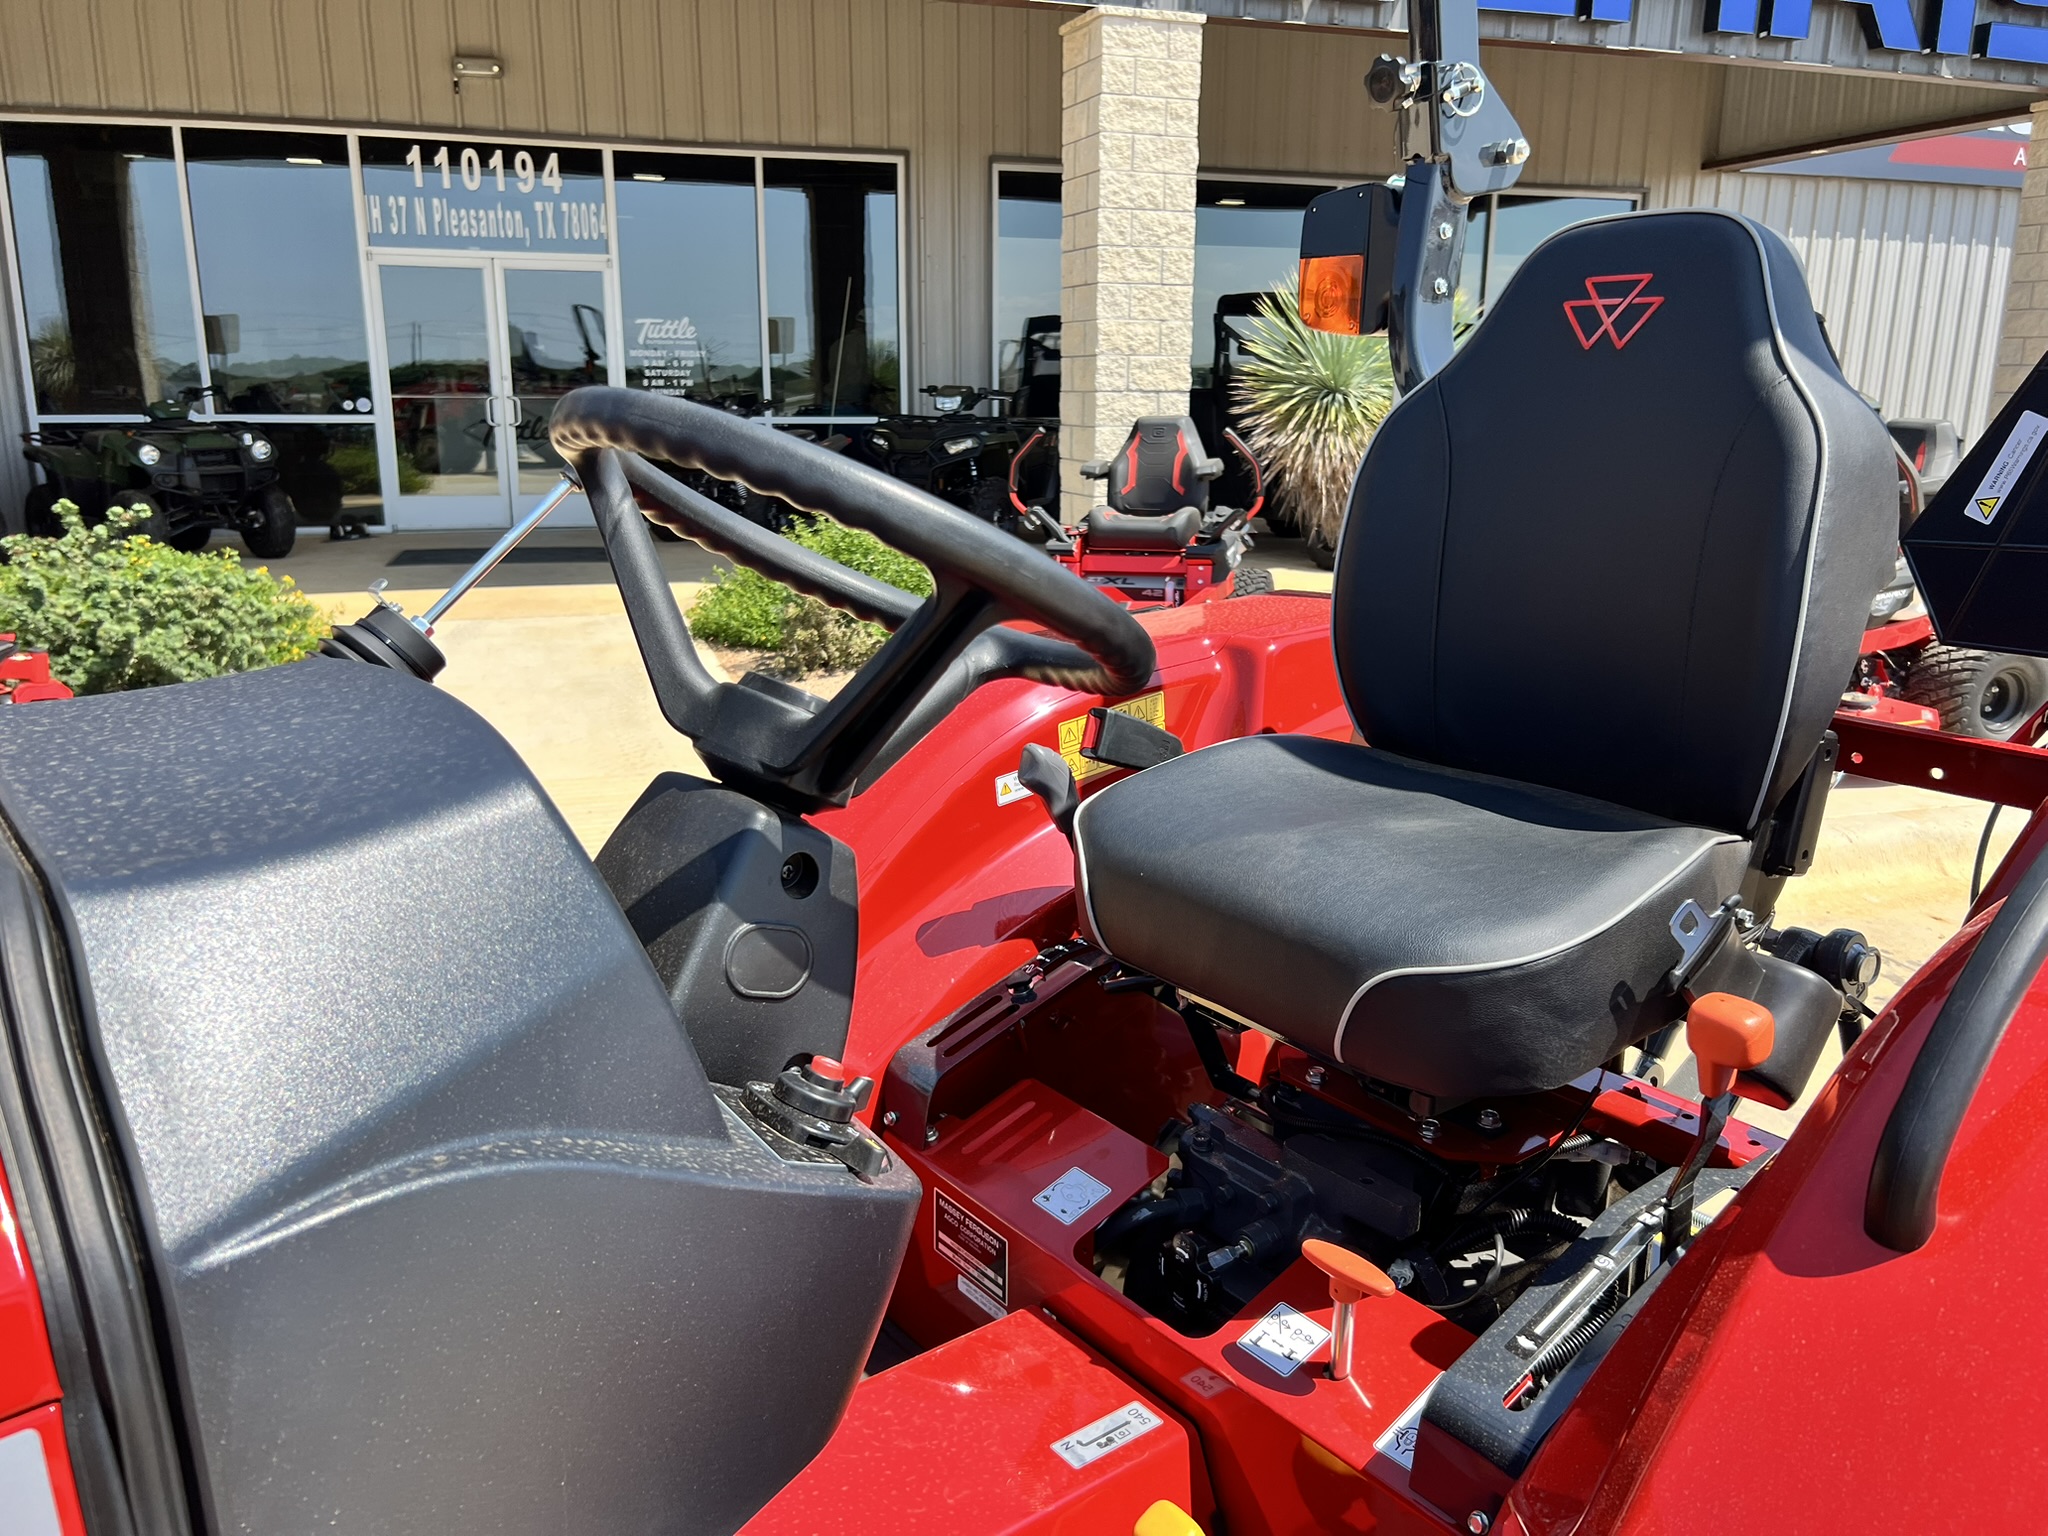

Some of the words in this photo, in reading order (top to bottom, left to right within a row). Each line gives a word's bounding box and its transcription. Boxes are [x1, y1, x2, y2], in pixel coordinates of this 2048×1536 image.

[406, 145, 563, 195] 110194
[388, 195, 407, 235] 37
[414, 197, 427, 236] N
[432, 198, 531, 247] Pleasanton,
[534, 201, 557, 240] TX
[561, 202, 608, 241] 78064
[634, 316, 698, 345] Tuttle
[629, 350, 668, 358] MONDAY
[674, 350, 707, 358] FRIDAY
[650, 388, 686, 397] SUNDAY
[651, 379, 665, 387] AM
[680, 379, 694, 387] PM
[939, 1198, 965, 1223] MASSEY
[965, 1217, 1000, 1249] FERGUSON
[944, 1213, 959, 1228] AGCO
[960, 1224, 996, 1257] CORPORATION
